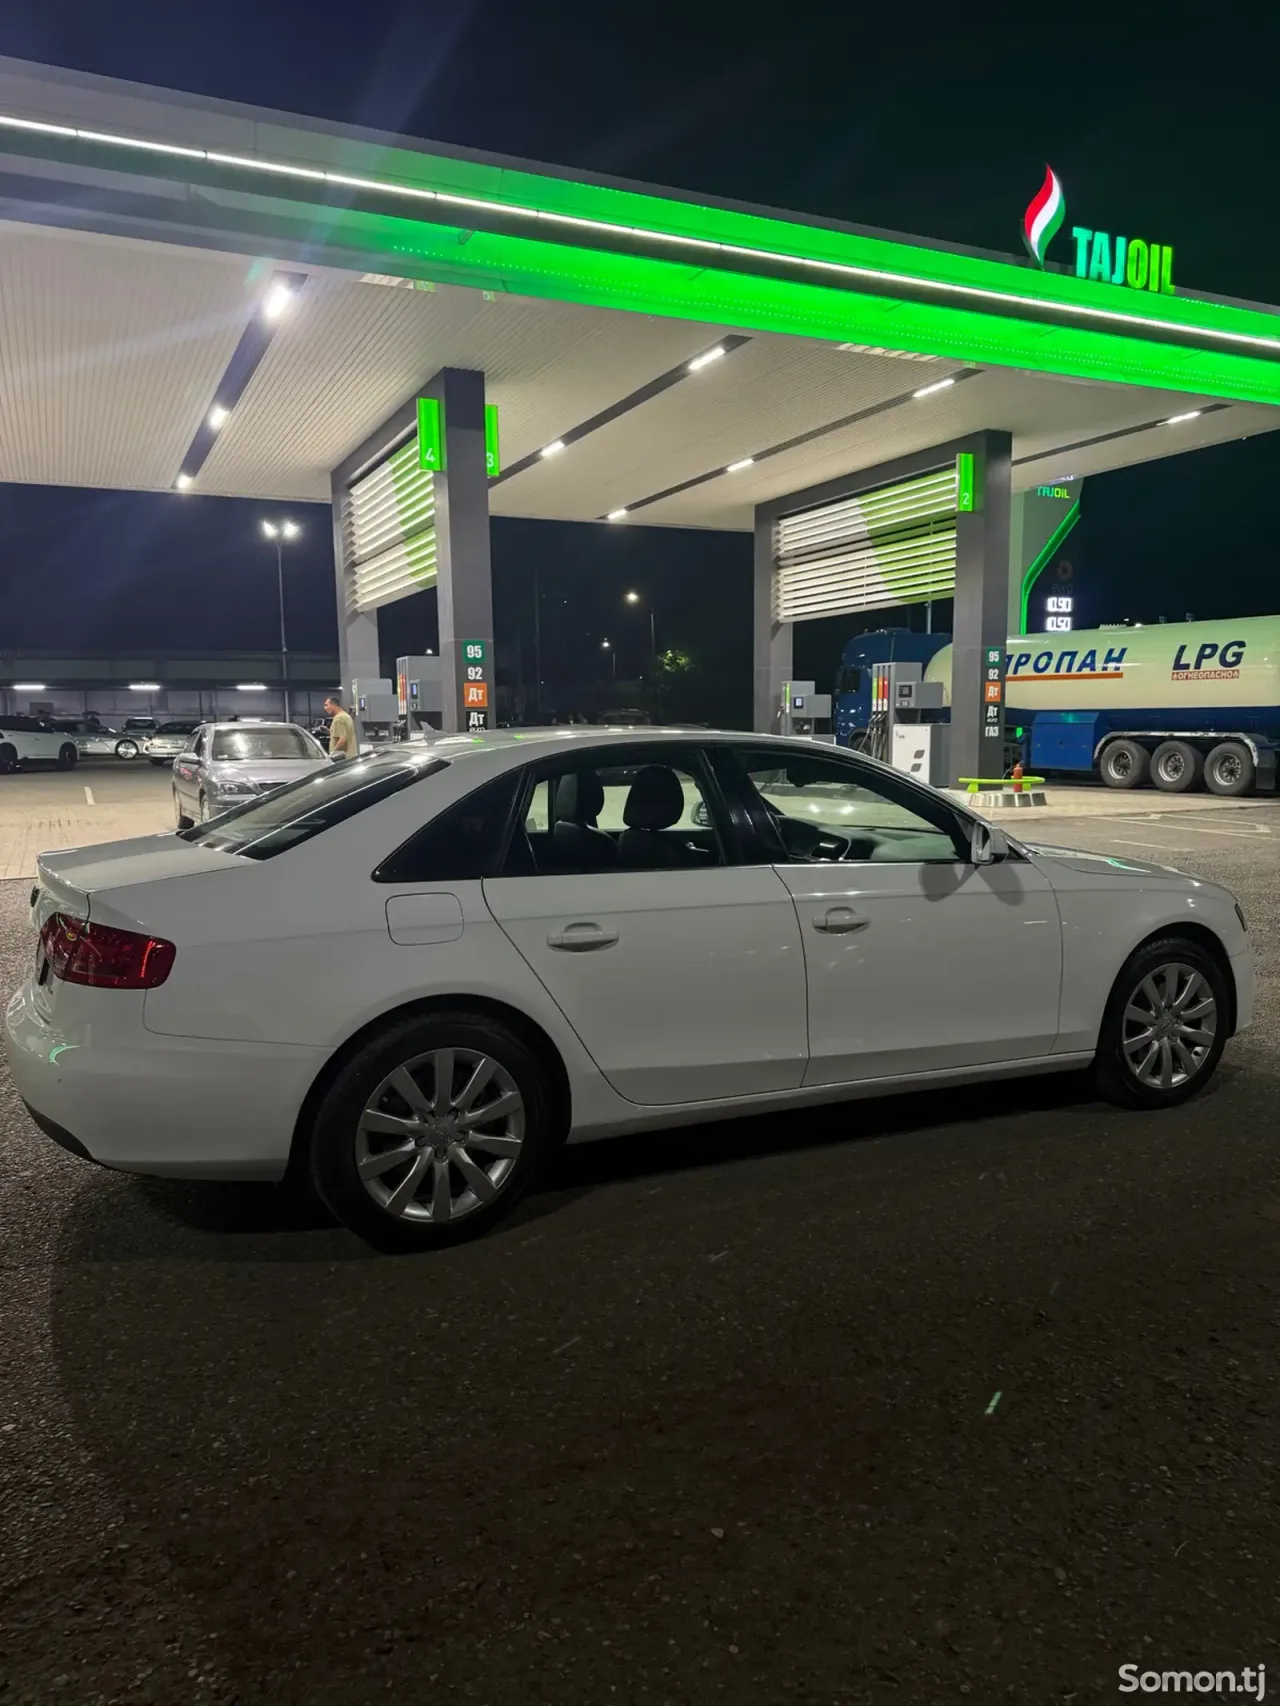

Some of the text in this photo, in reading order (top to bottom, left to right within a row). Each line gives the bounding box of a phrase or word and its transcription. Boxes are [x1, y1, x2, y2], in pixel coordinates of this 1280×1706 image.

[1072, 226, 1176, 296] TAJOIL
[425, 447, 436, 462] 4
[486, 451, 494, 468] 3
[962, 492, 970, 505] 2
[466, 644, 483, 659] 95
[988, 650, 1001, 662] 95
[1172, 640, 1247, 671] LPG
[467, 666, 483, 680] 92
[988, 668, 999, 680] 92
[1177, 670, 1234, 680] ОГНЕОПАСНО
[468, 687, 484, 703] Дт
[988, 685, 999, 699] Дт
[986, 705, 998, 718] Дт
[468, 711, 485, 727] Дт
[984, 726, 999, 738] ГАЗ
